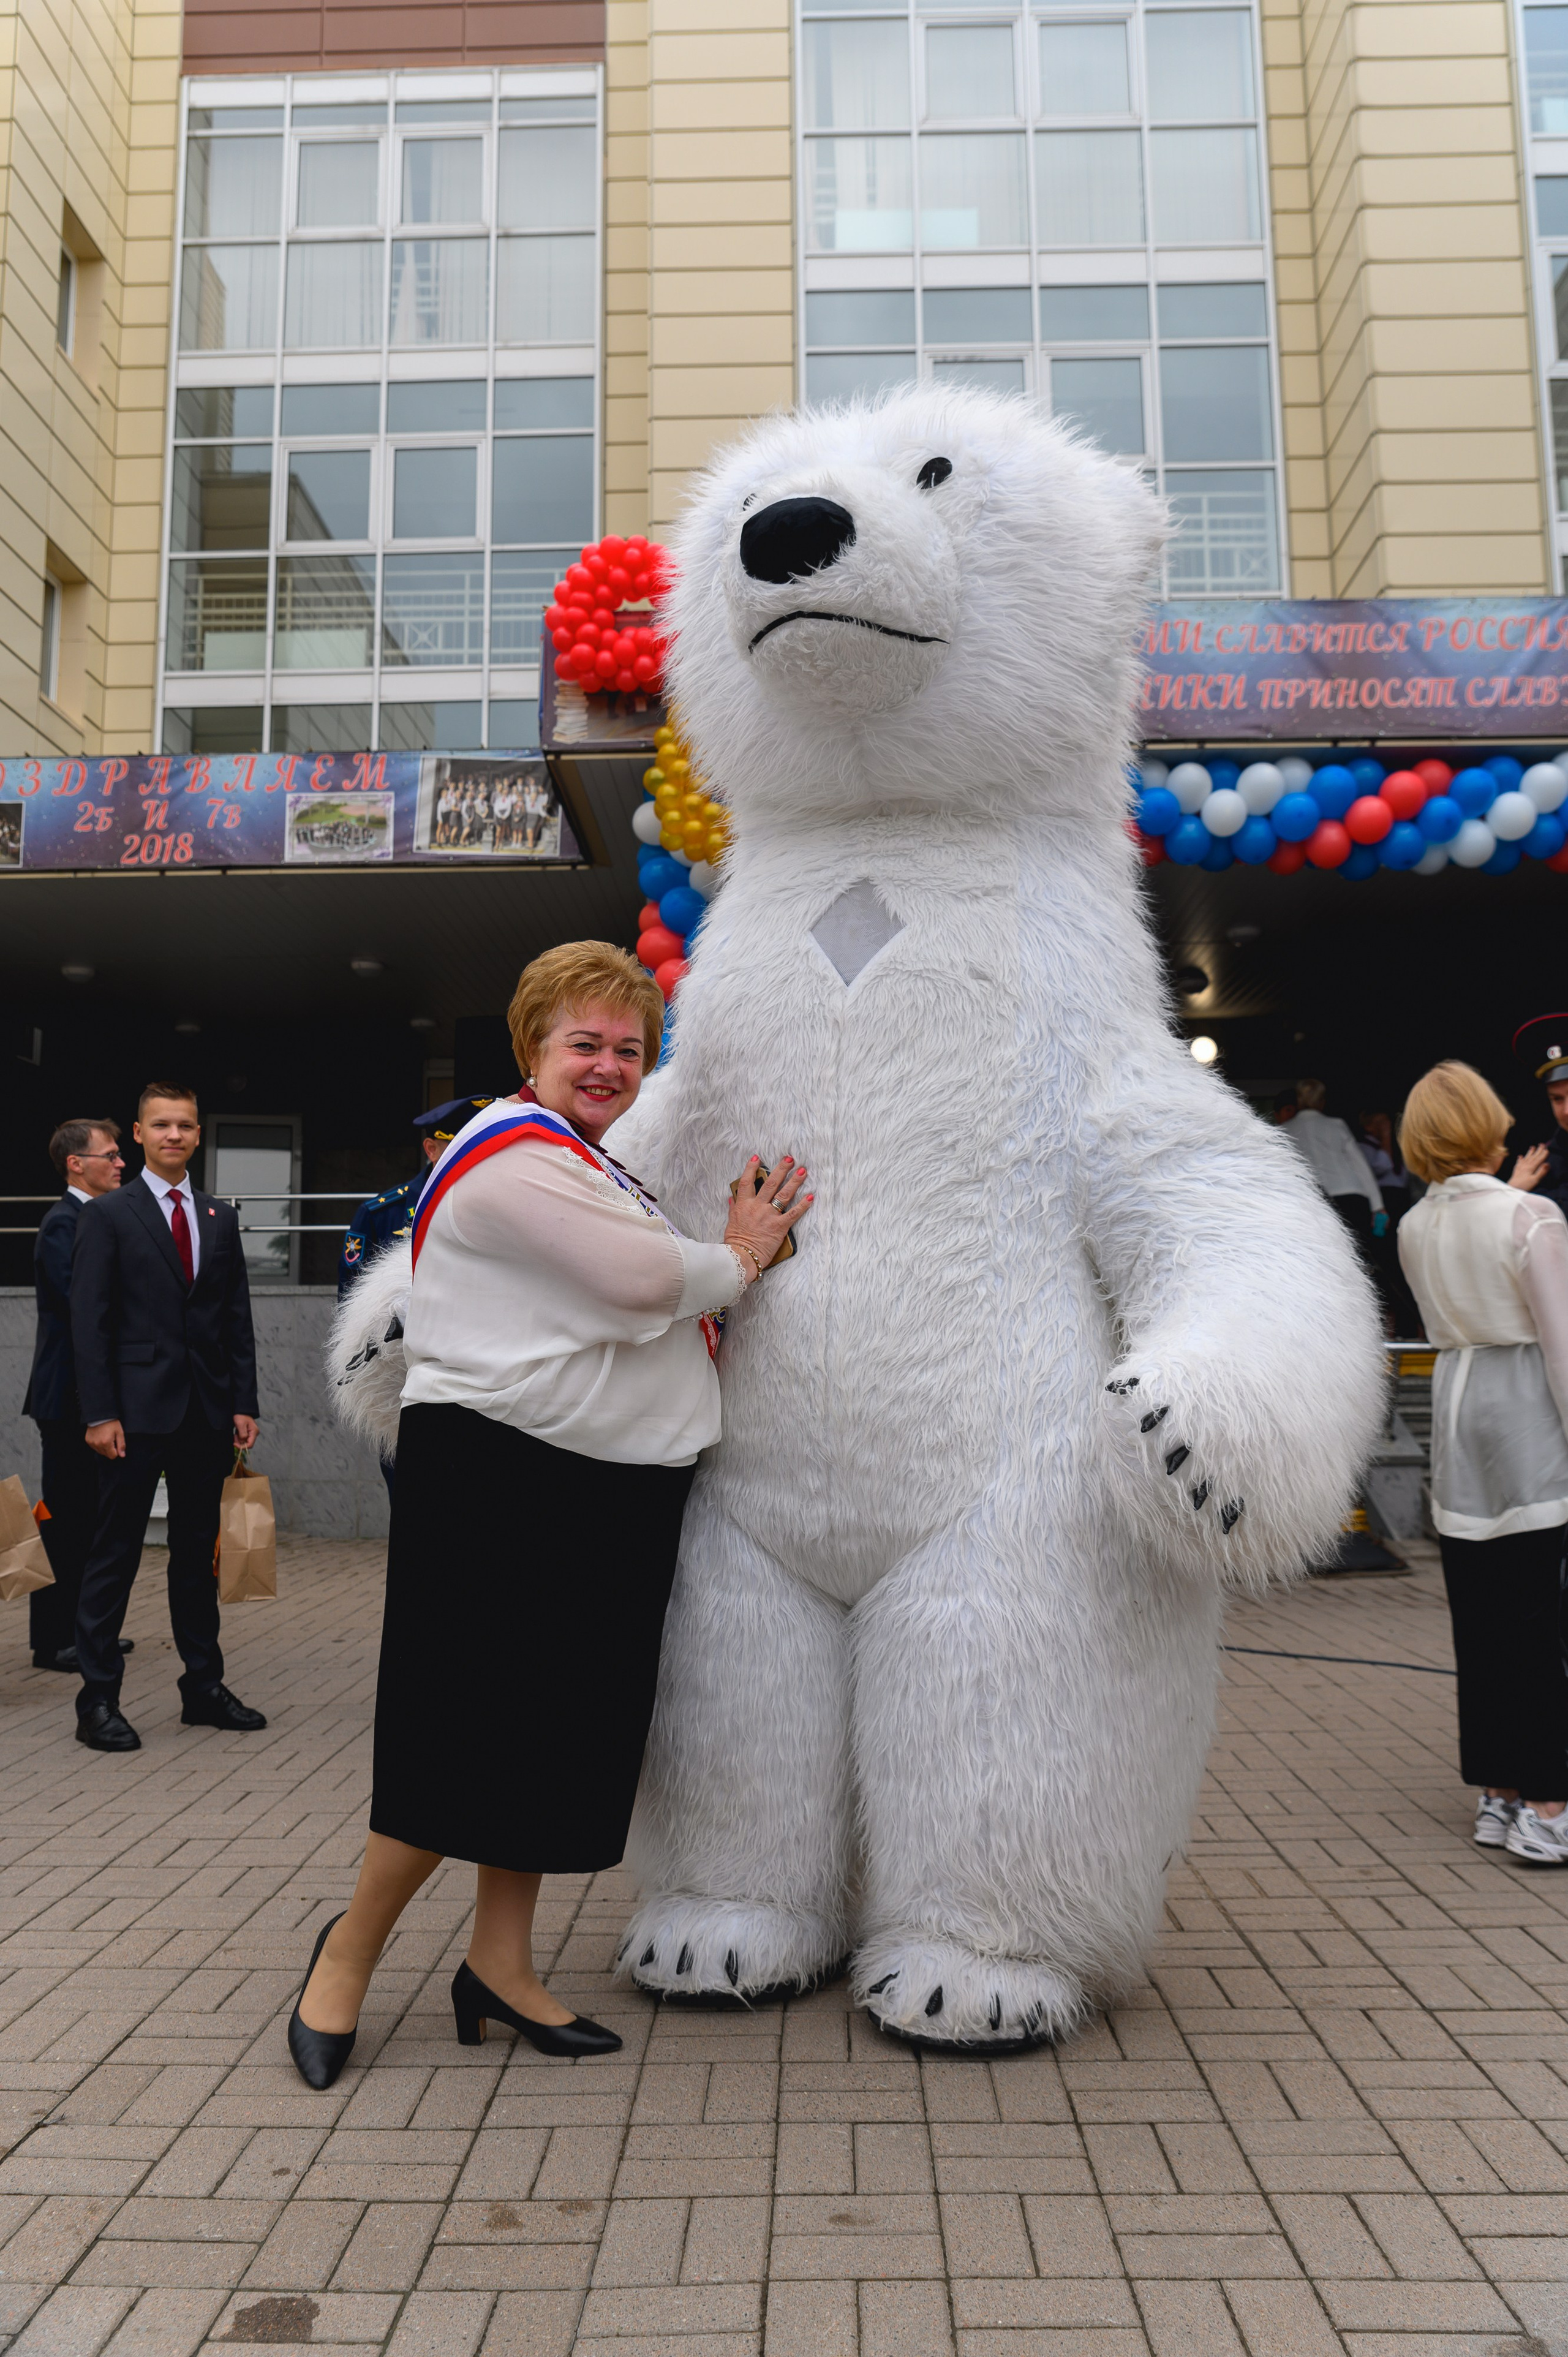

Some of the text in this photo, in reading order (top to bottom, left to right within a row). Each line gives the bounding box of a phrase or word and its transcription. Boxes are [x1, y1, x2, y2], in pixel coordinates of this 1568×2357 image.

[1214, 622, 1411, 654] СЛАВИТСЯ
[1257, 677, 1457, 709] ПРИНОСЯТ
[1464, 675, 1568, 707] СЛАВ
[0, 753, 390, 796] ЗДРАВЛЯЕМ
[120, 832, 194, 865] 2018
